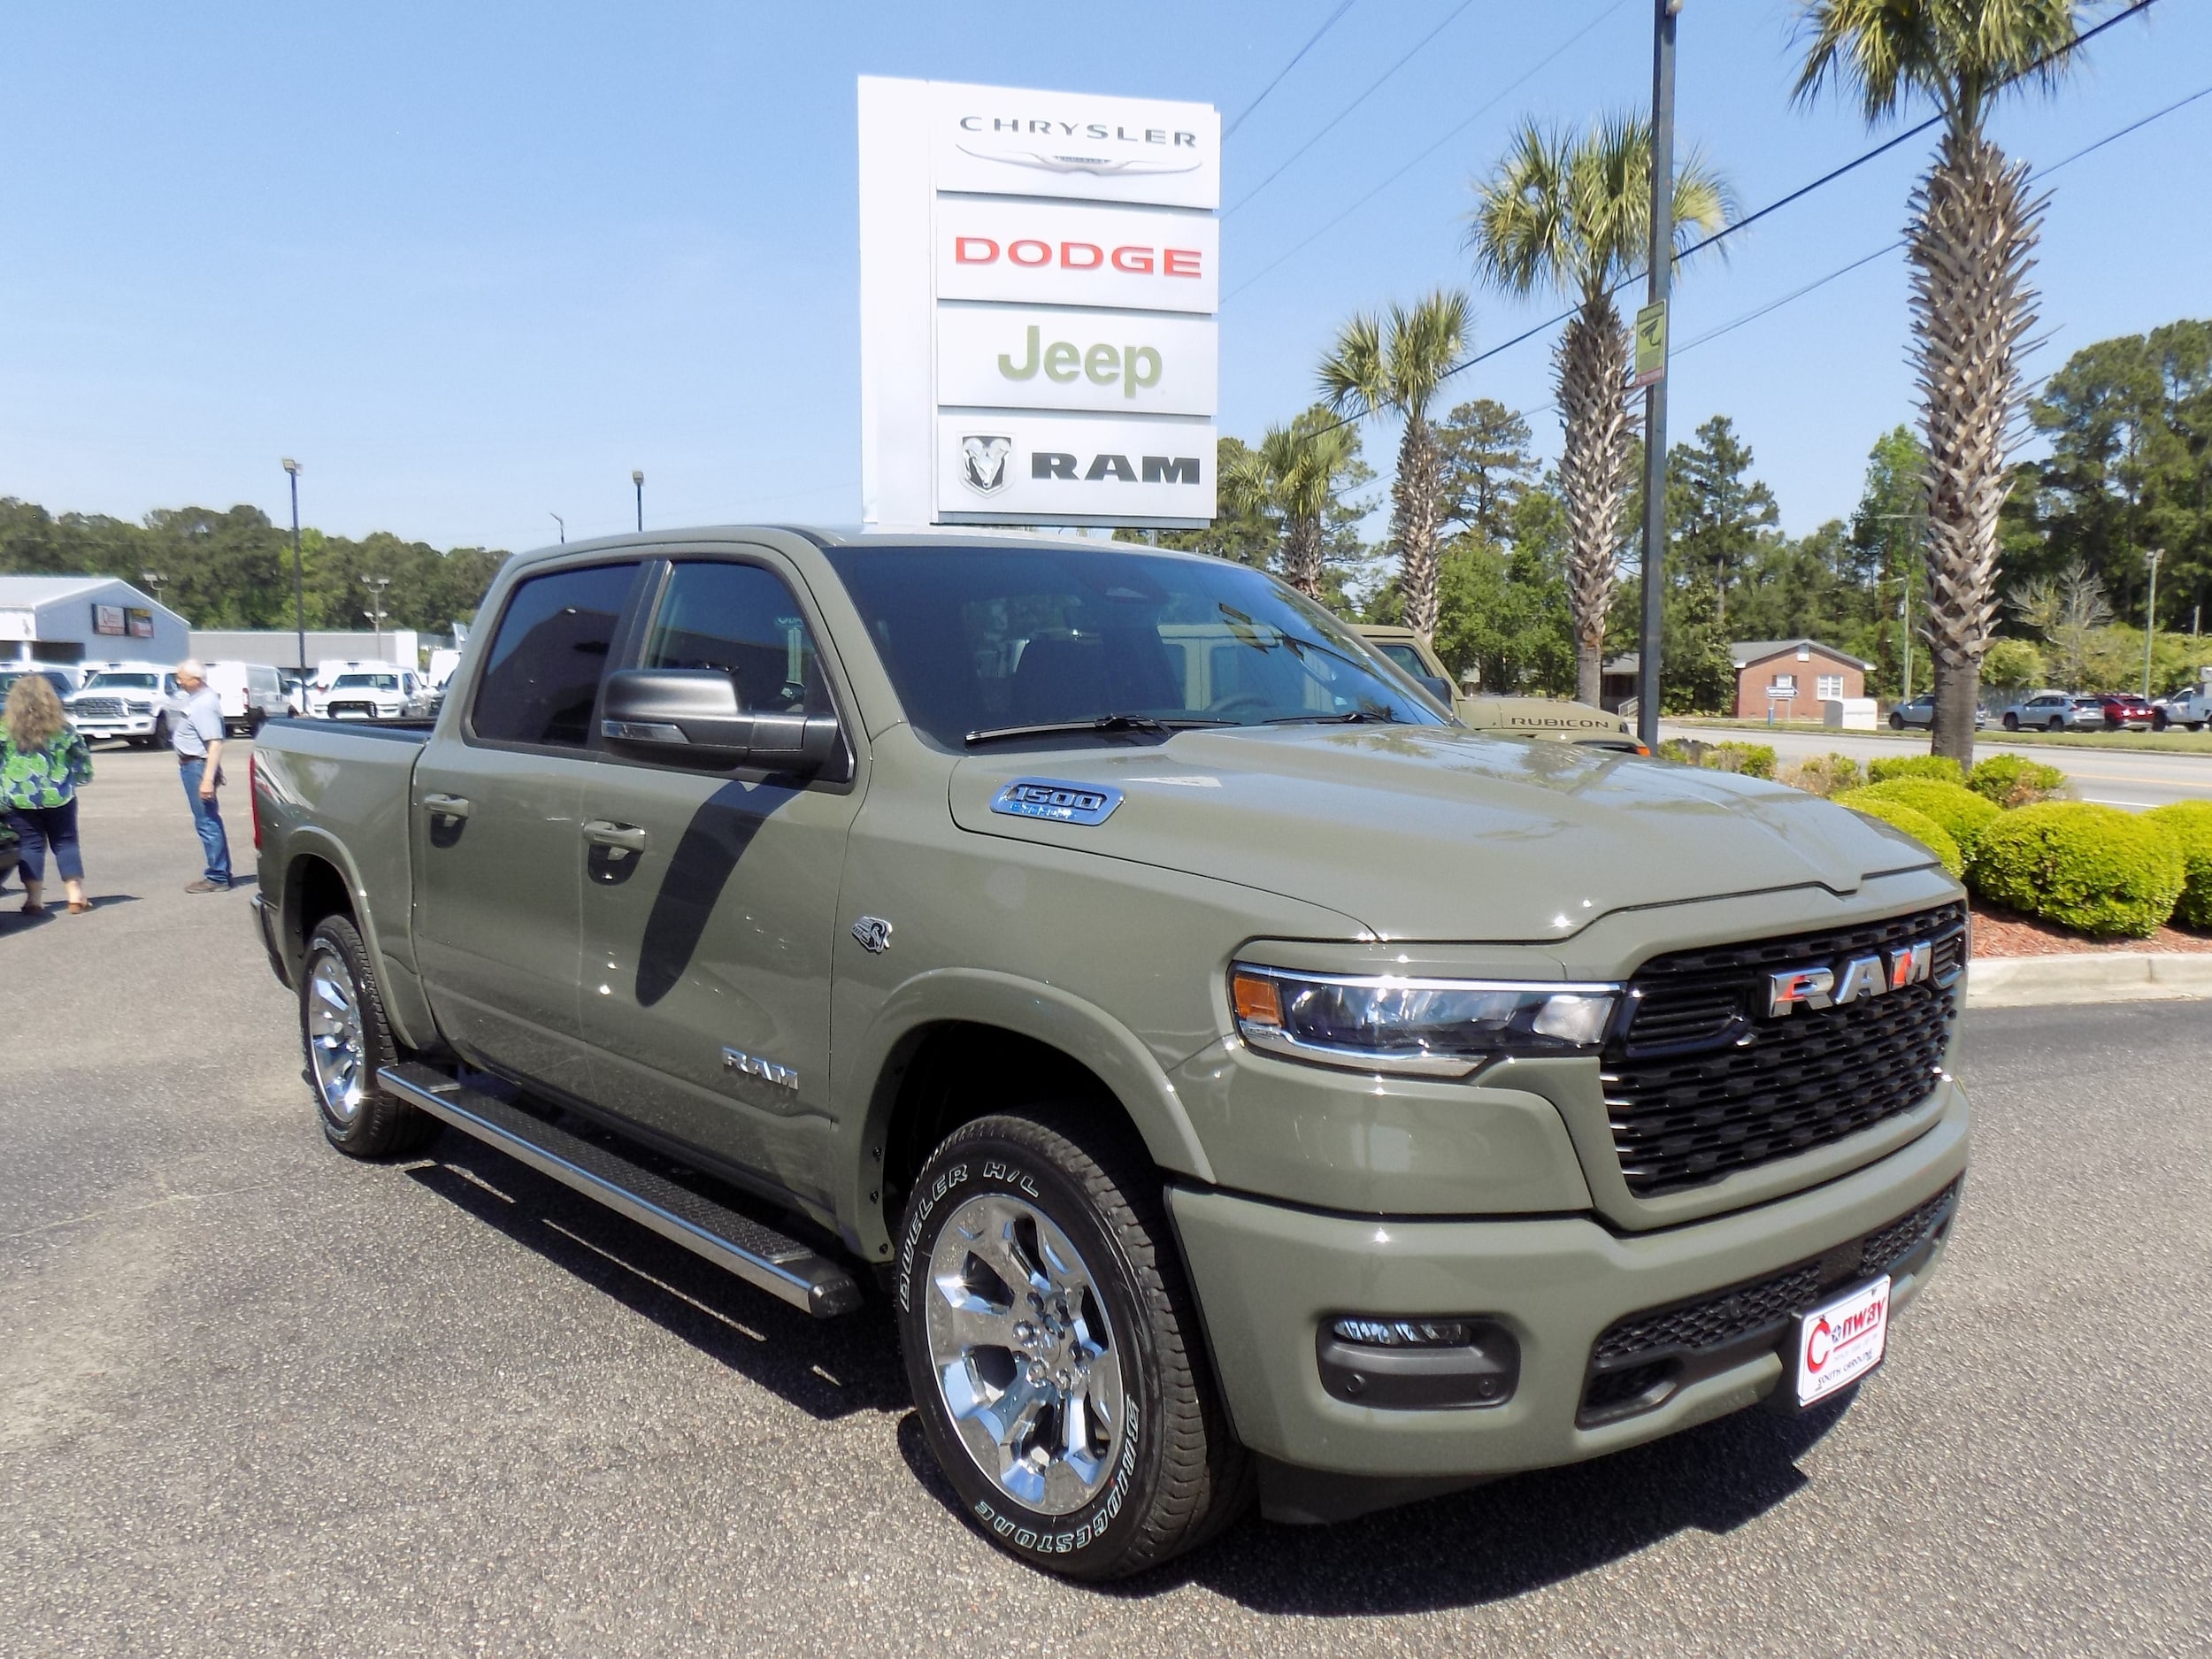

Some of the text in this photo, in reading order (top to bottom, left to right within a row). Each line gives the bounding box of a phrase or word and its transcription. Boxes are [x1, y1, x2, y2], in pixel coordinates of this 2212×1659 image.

[959, 116, 1197, 148] CHRYSLER
[956, 236, 1202, 279] DODGE
[997, 325, 1163, 398] Jeep
[1032, 451, 1201, 485] RAM
[1511, 717, 1609, 728] RUBICON
[1004, 784, 1104, 811] 1500
[1770, 939, 1932, 1018] RAM
[722, 1047, 799, 1090] RAM
[899, 1161, 1039, 1313] DUELER H/L
[974, 1394, 1141, 1554] BRIDGESTONE
